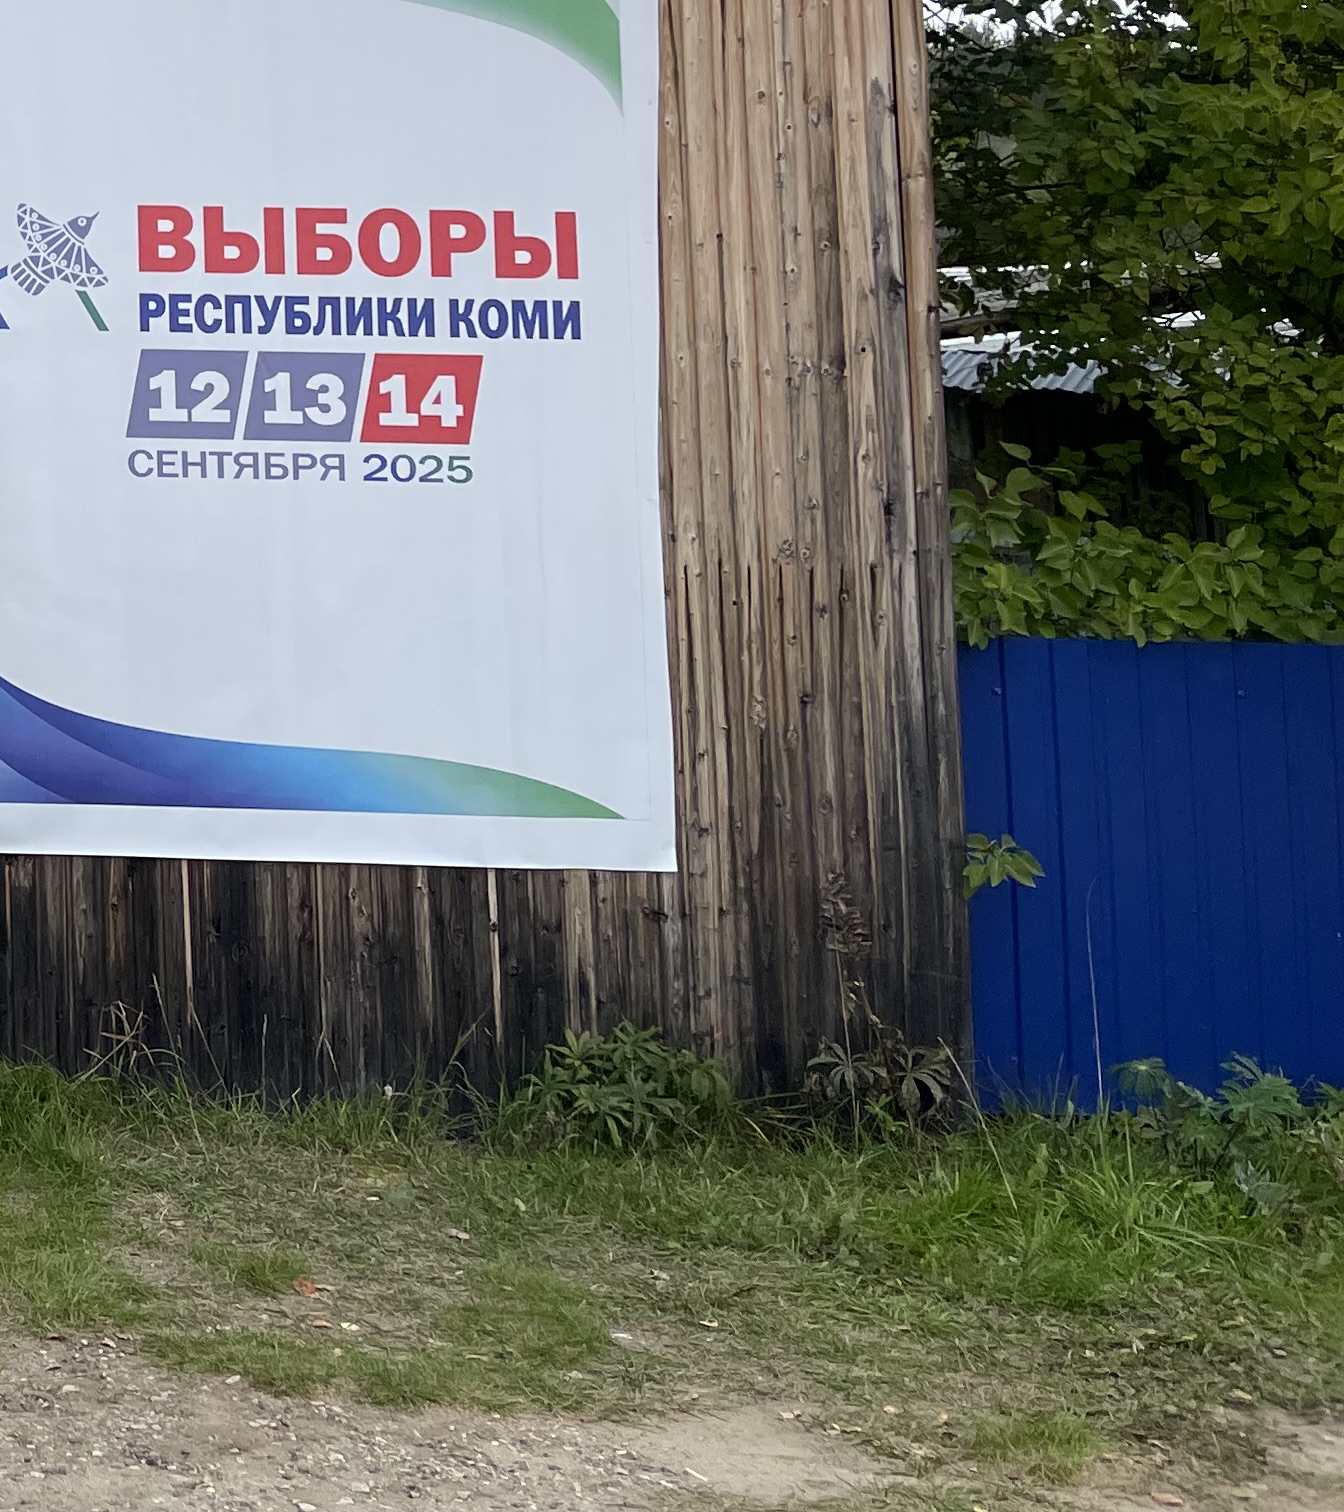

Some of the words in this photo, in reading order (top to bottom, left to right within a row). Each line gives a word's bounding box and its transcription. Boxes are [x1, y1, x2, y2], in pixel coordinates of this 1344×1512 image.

[137, 204, 579, 280] ВЫБОРЫ
[138, 292, 435, 338] РЕСПУБЛИКИ
[448, 298, 582, 340] КОМИ
[146, 369, 232, 424] 12
[262, 372, 348, 427] 13
[377, 374, 464, 427] 14
[127, 449, 346, 483] СЕНТЯБРЯ
[362, 453, 474, 484] 2025
